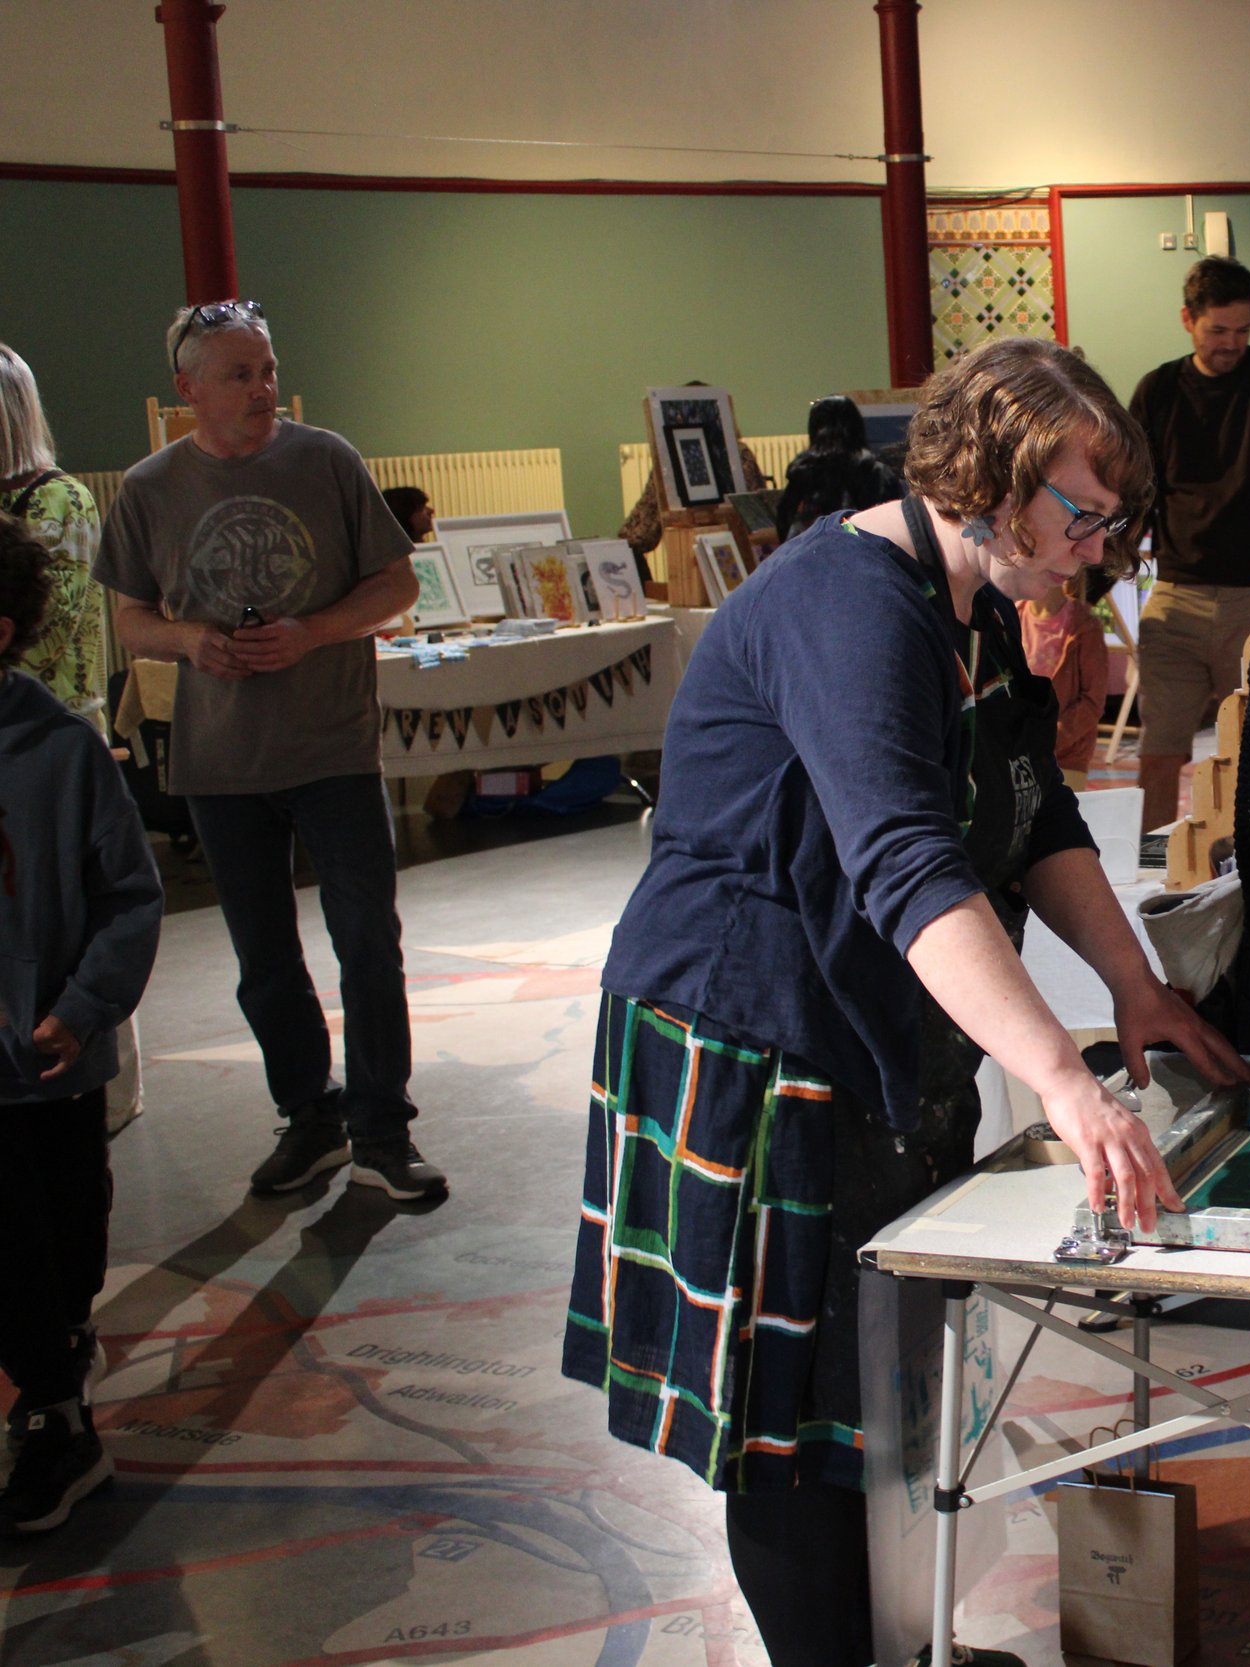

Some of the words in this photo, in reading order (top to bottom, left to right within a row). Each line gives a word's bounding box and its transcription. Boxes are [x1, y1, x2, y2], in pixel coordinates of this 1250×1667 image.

[345, 1343, 537, 1379] Drighlington
[387, 1383, 519, 1413] Adwalton
[384, 1621, 472, 1642] A643
